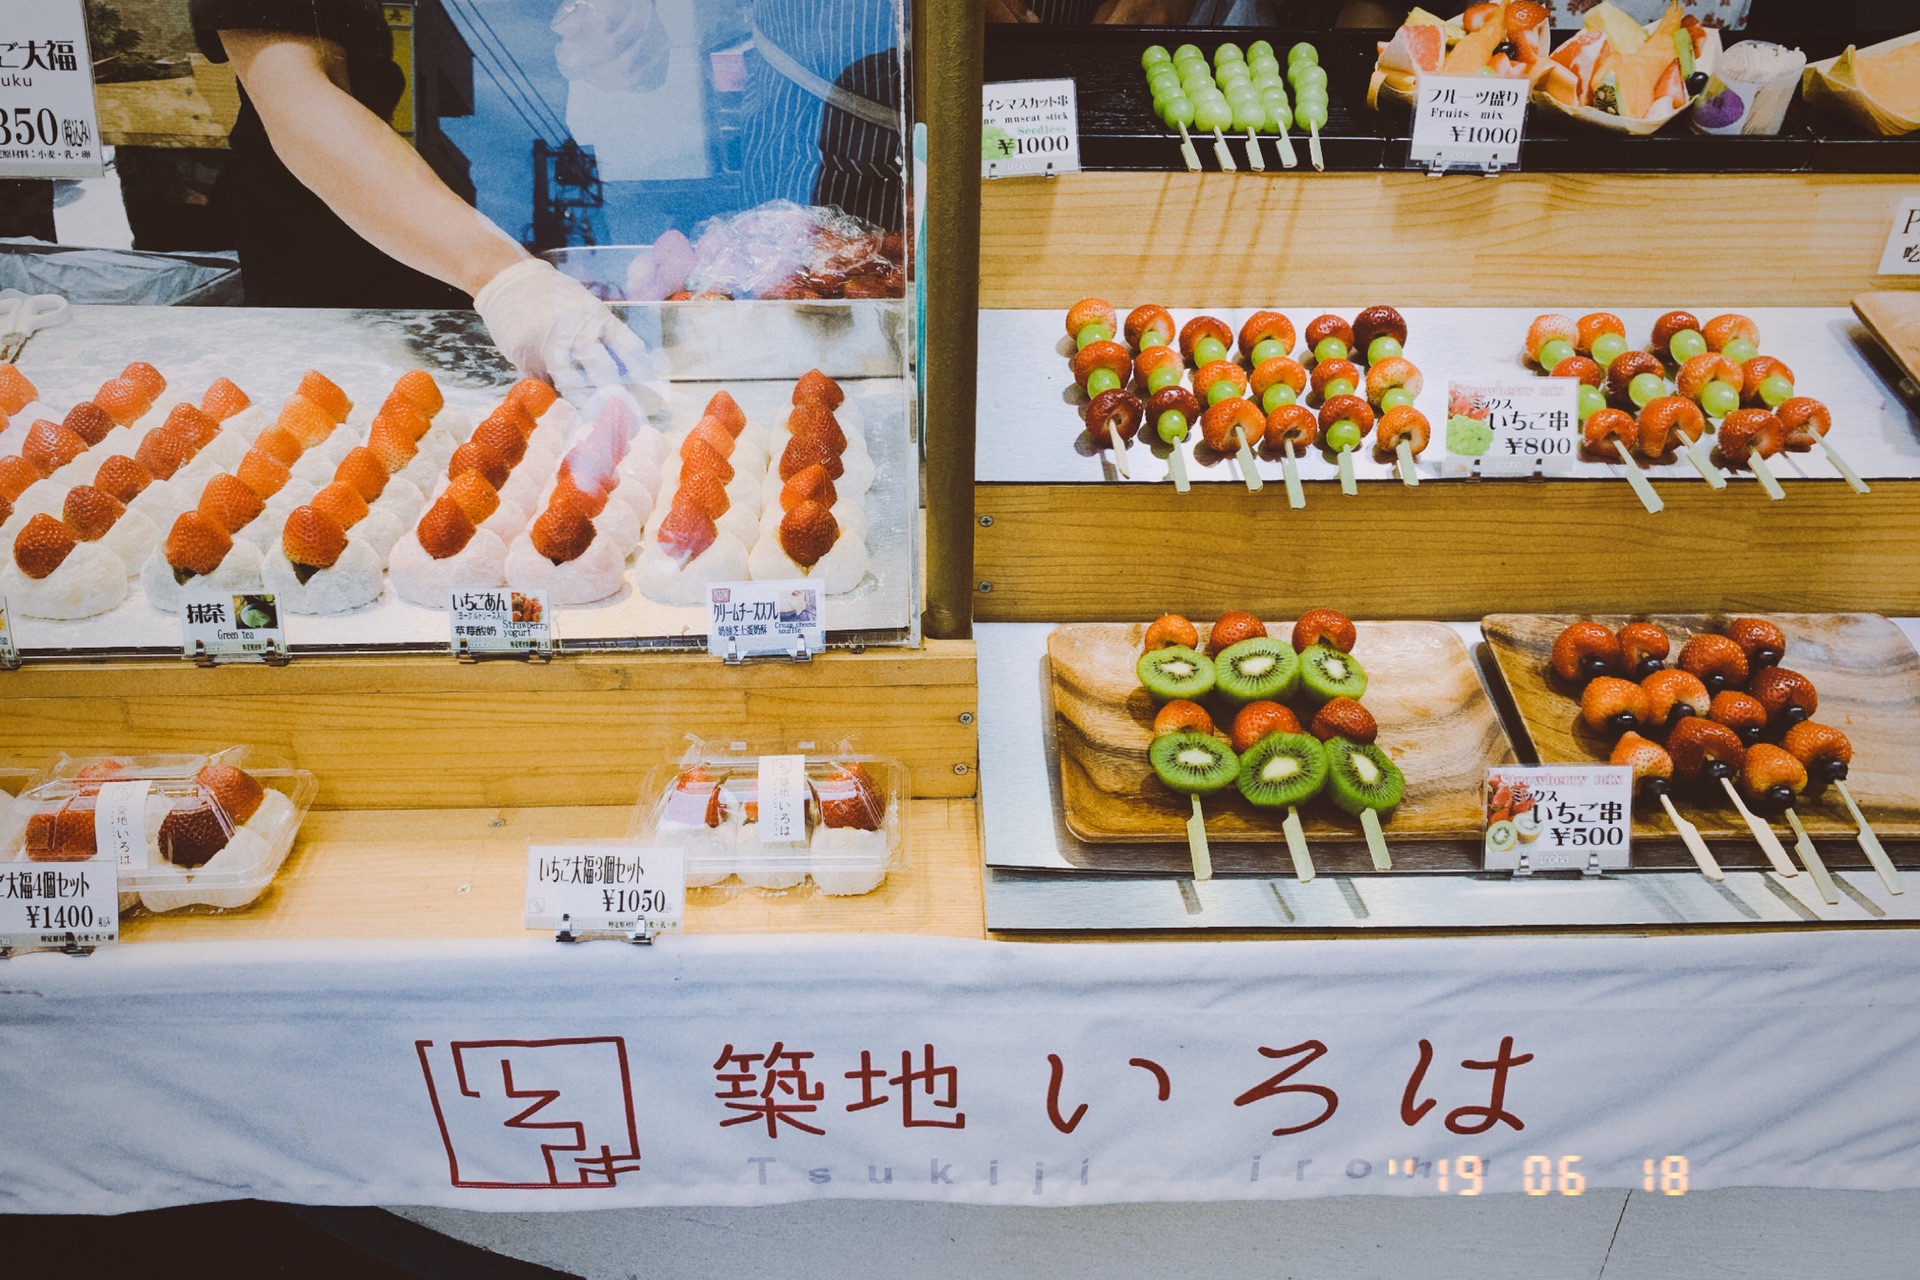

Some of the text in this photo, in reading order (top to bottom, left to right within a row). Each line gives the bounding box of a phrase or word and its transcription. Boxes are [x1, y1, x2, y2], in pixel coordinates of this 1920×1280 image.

[1428, 89, 1519, 107] フルーツ盛り
[1005, 114, 1040, 124] muscat
[1045, 112, 1069, 120] stick
[1431, 107, 1503, 120] Fruits mix
[1017, 125, 1067, 135] Seedless
[1449, 126, 1518, 144] ¥1000
[998, 135, 1069, 155] ¥1000
[1541, 385, 1565, 396] mix
[1473, 398, 1513, 410] ミックス
[1489, 411, 1569, 431] いちご串
[1505, 437, 1571, 455] ¥800
[452, 593, 508, 611] いちごあん
[186, 603, 226, 624] 抹茶
[217, 629, 254, 640] Green tea
[502, 620, 548, 631] Strawberry
[503, 629, 532, 638] yogurt
[1500, 773, 1623, 786] Strawberry mix
[1512, 790, 1558, 803] ミックス
[1533, 801, 1622, 824] いちご串
[1550, 826, 1623, 846] ¥500
[1538, 853, 1570, 865] iroha
[539, 855, 644, 884] いちご大福3個セット
[603, 889, 666, 913] ¥1050
[26, 905, 93, 929] ¥1400
[747, 1156, 1090, 1195] Tsukiji
